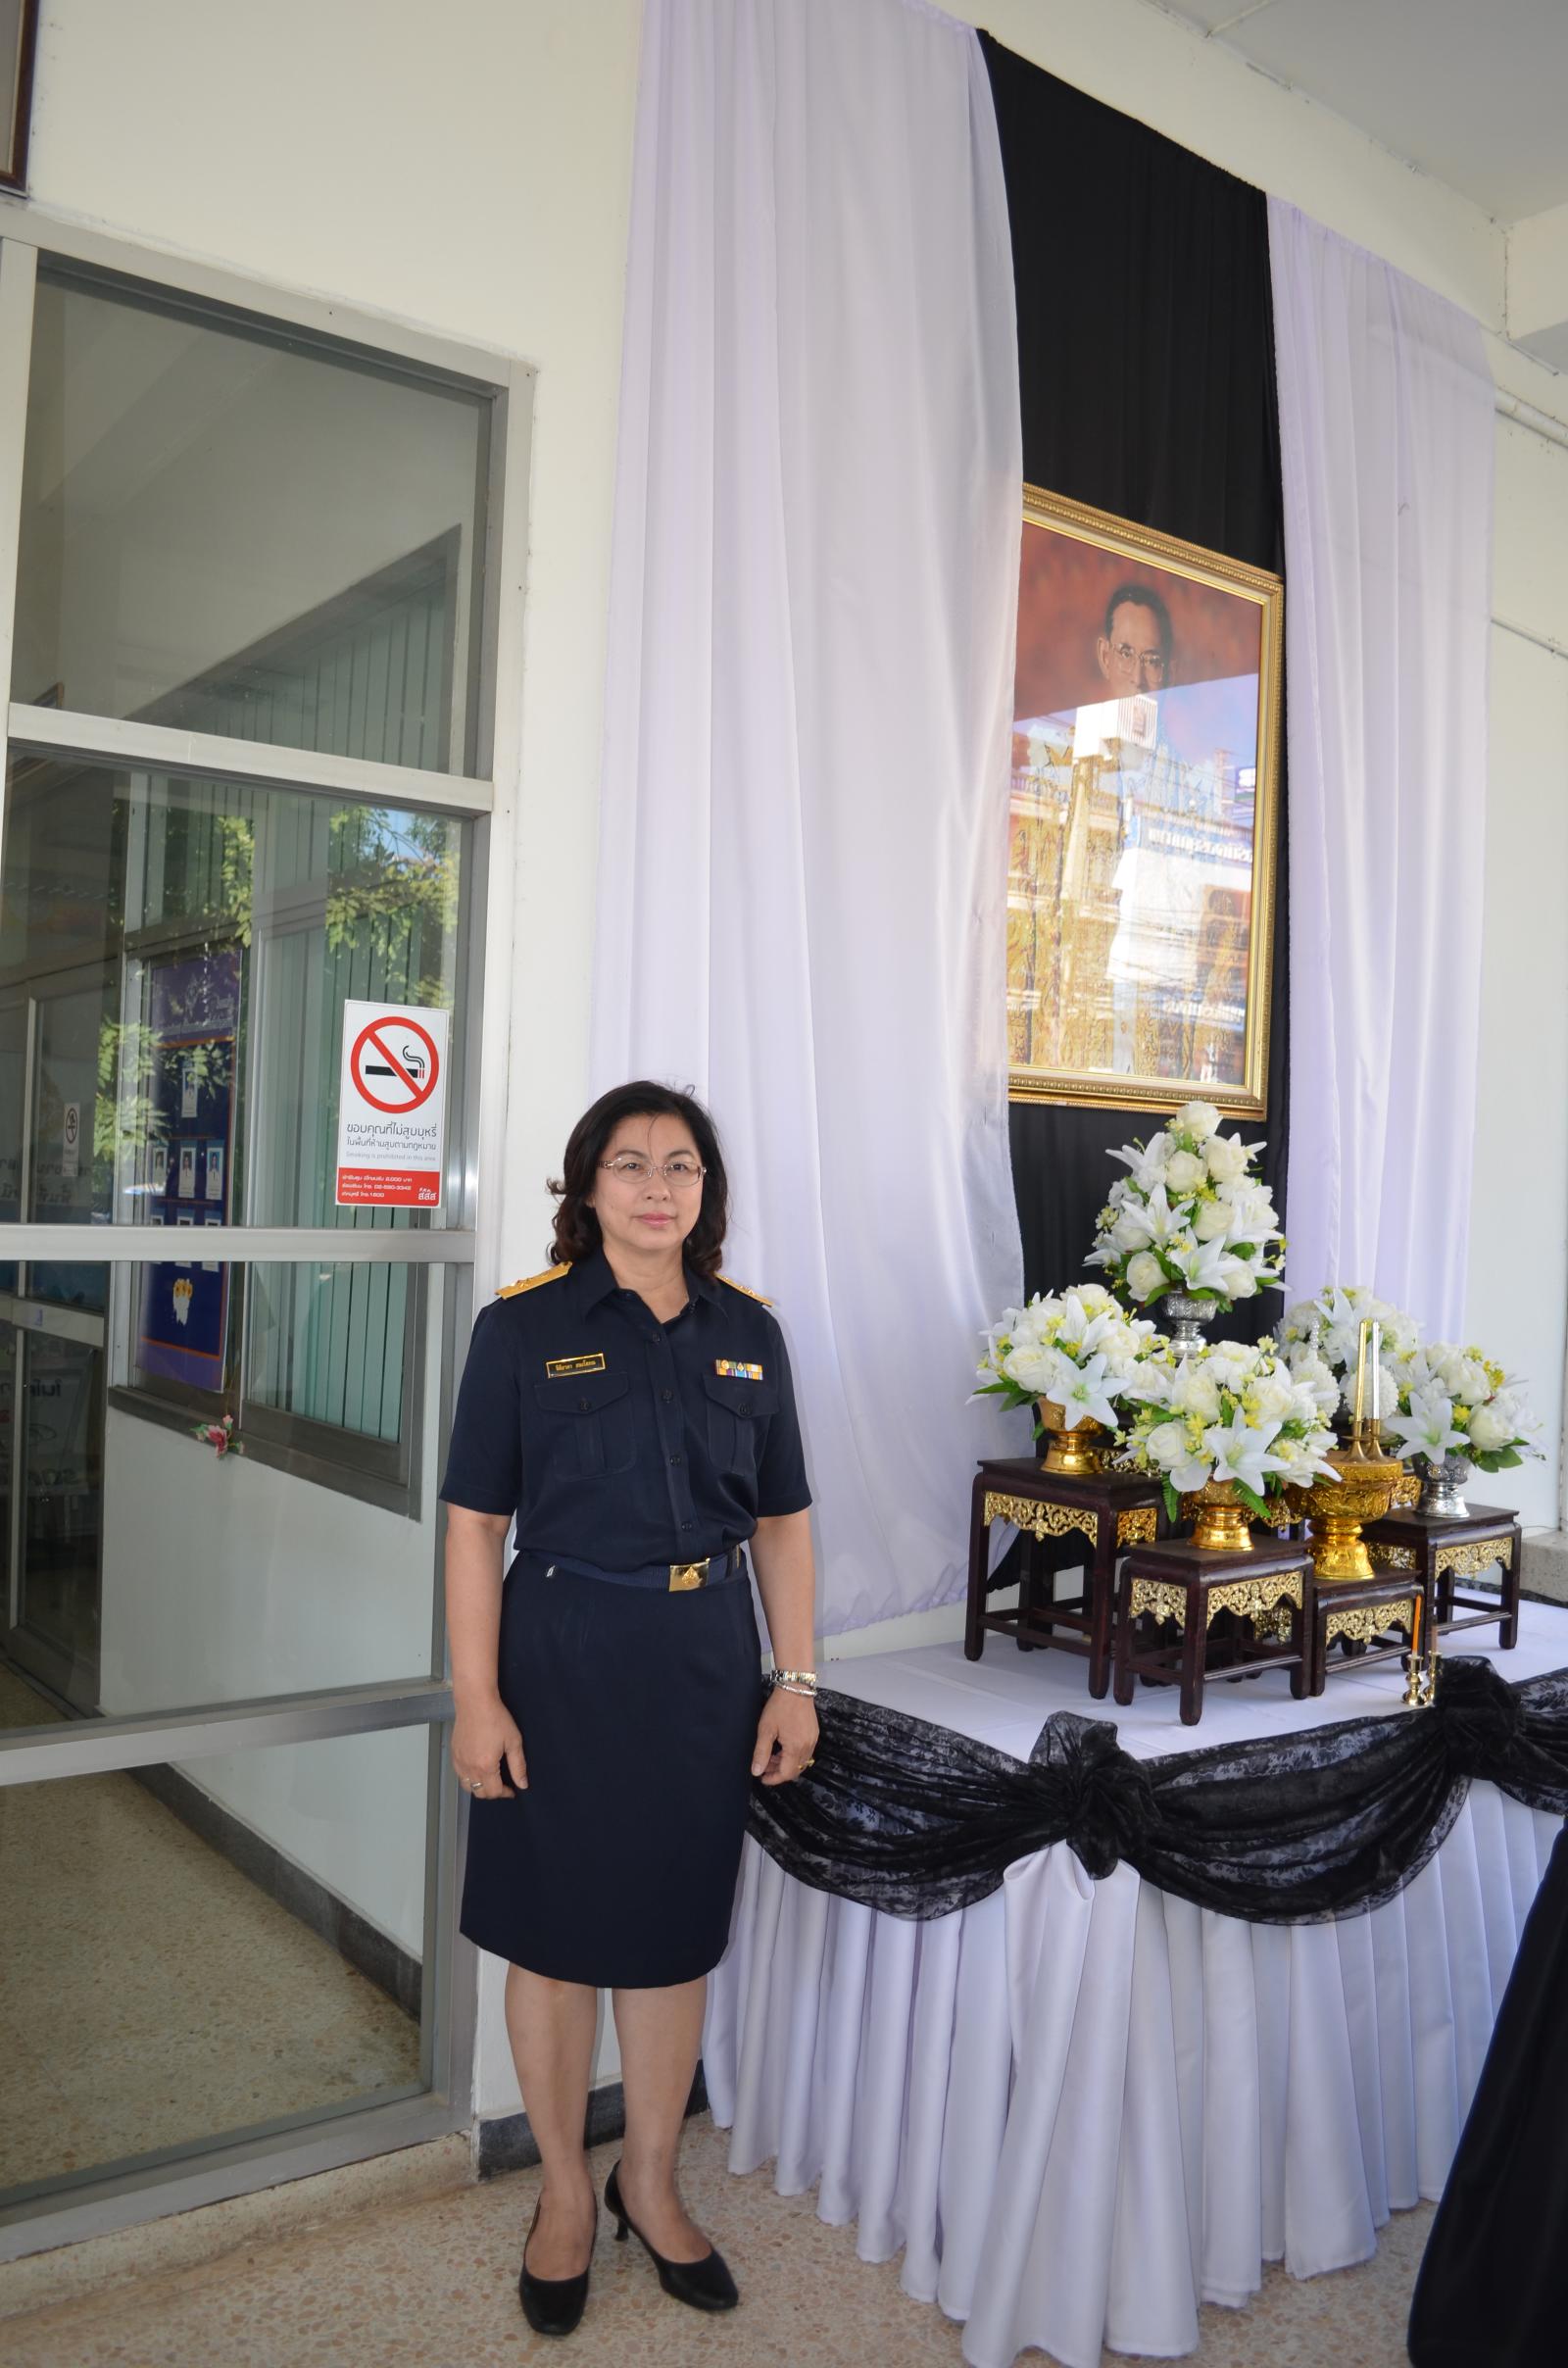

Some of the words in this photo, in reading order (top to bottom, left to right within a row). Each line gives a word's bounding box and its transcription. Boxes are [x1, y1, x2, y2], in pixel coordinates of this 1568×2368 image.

[347, 1121, 437, 1140] ขอบคุณที่ไม่สูบบุหรี่
